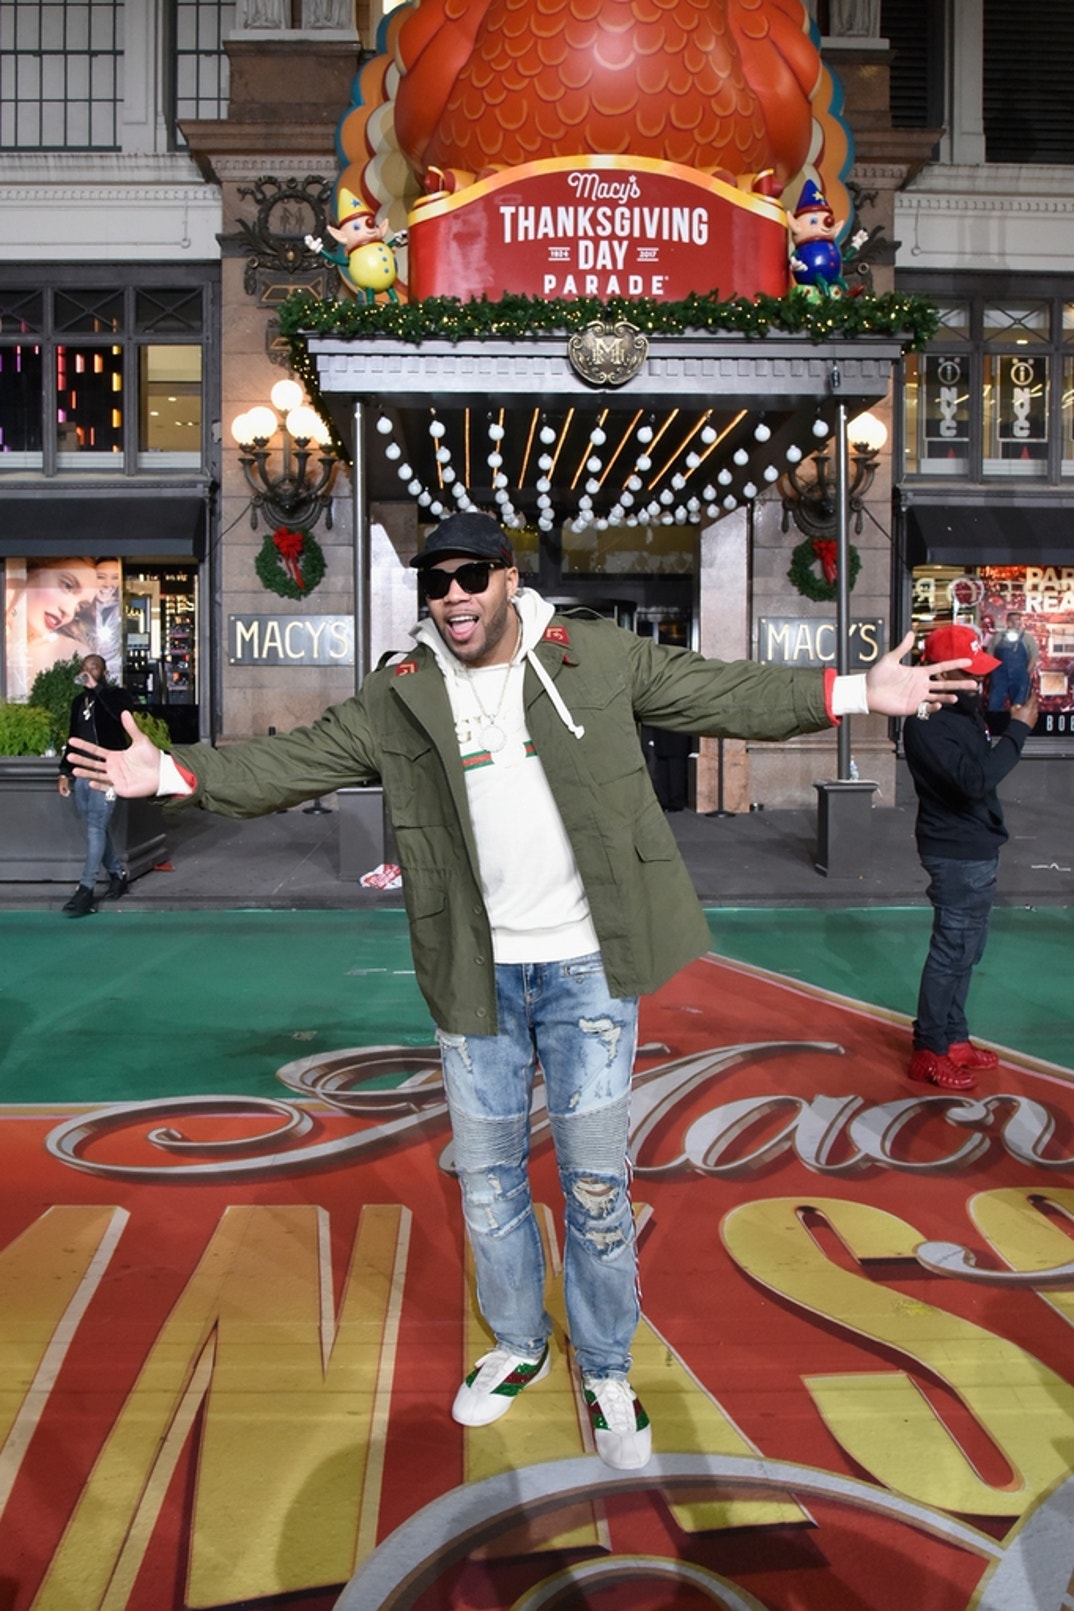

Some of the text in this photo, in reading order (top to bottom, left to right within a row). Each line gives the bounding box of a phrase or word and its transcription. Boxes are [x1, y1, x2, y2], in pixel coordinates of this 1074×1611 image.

[568, 172, 641, 204] Macy's
[499, 205, 709, 246] THANKSGIVING
[578, 240, 629, 270] DAY
[235, 620, 349, 659] MACY'S
[766, 623, 879, 662] MAC'S
